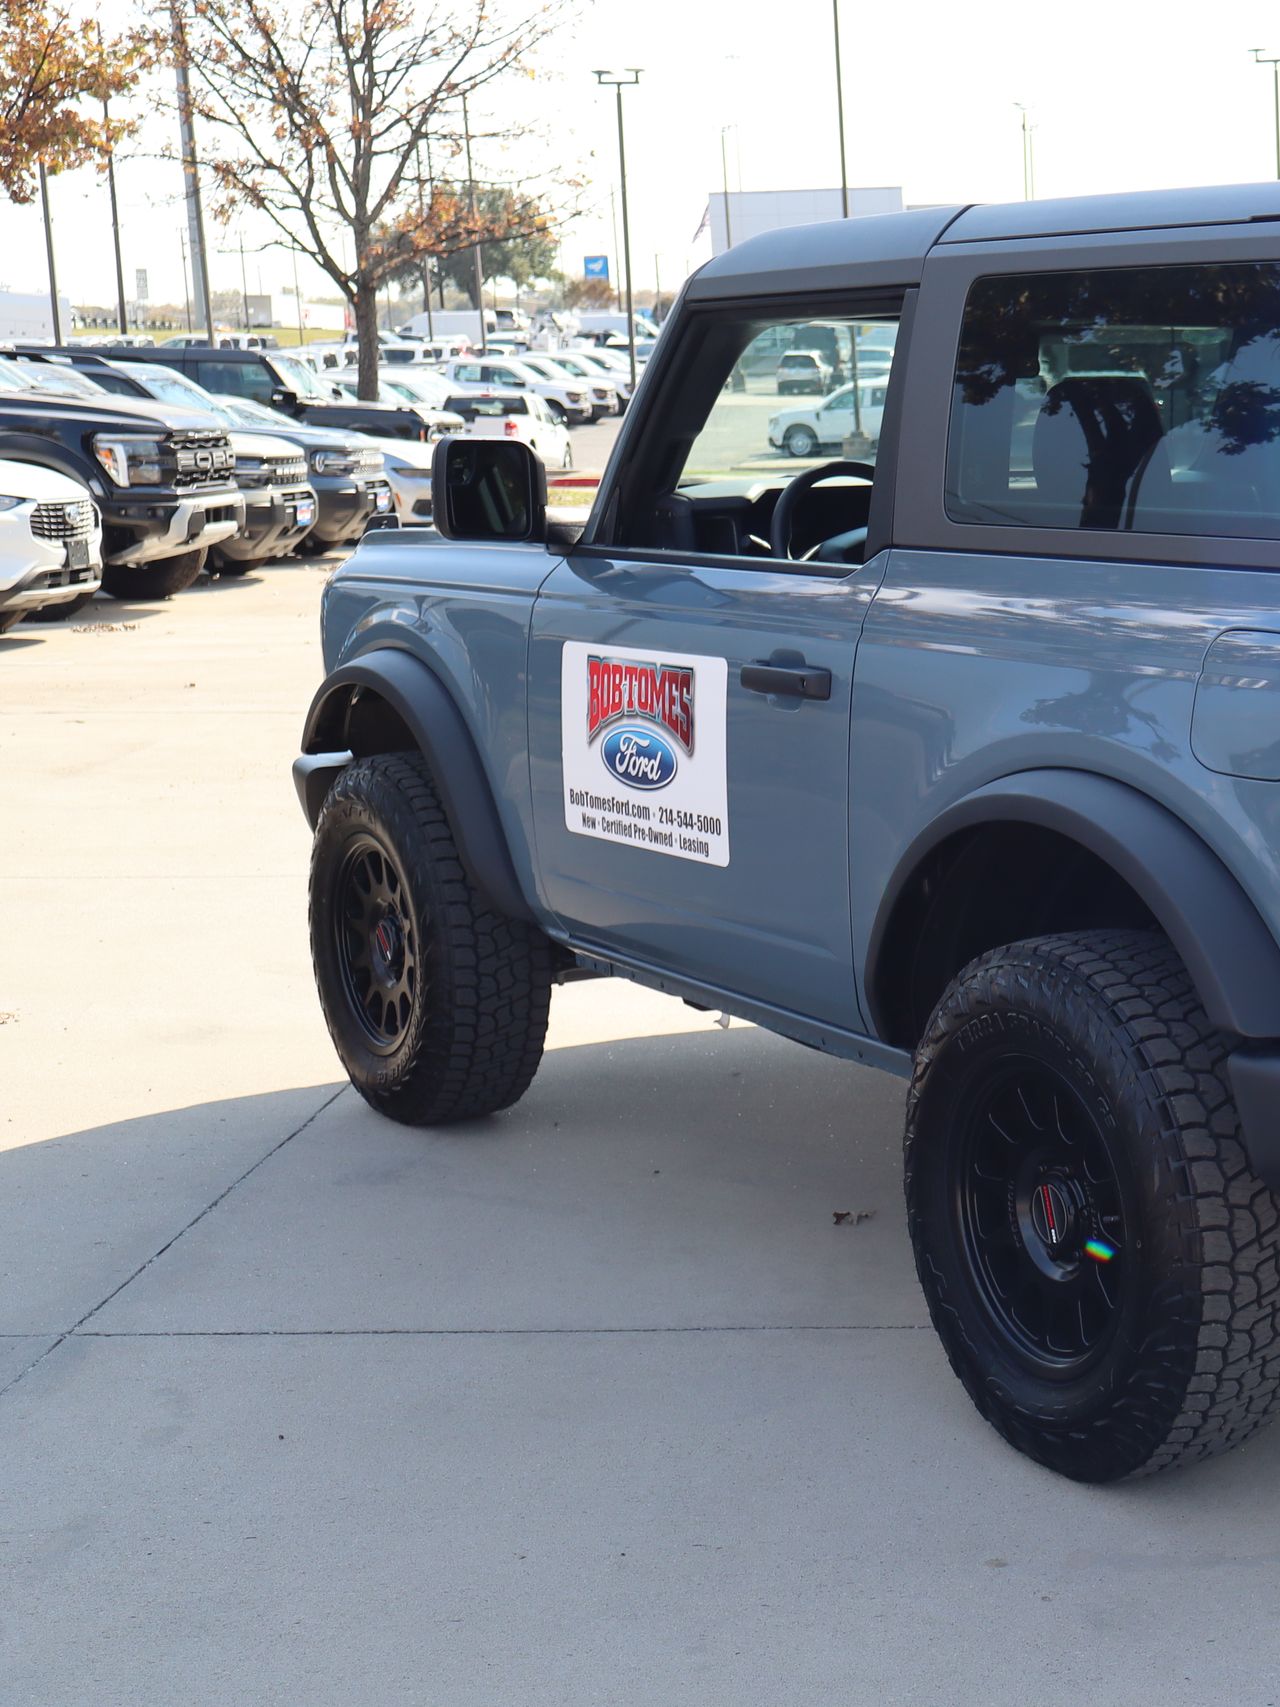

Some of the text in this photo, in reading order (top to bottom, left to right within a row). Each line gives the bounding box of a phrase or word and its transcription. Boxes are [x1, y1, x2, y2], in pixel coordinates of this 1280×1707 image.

[615, 733, 662, 781] Ford
[569, 788, 722, 836] BobTomesFord.com 214-544-5000
[581, 812, 710, 857] New Certified Pre-Owned Leasing
